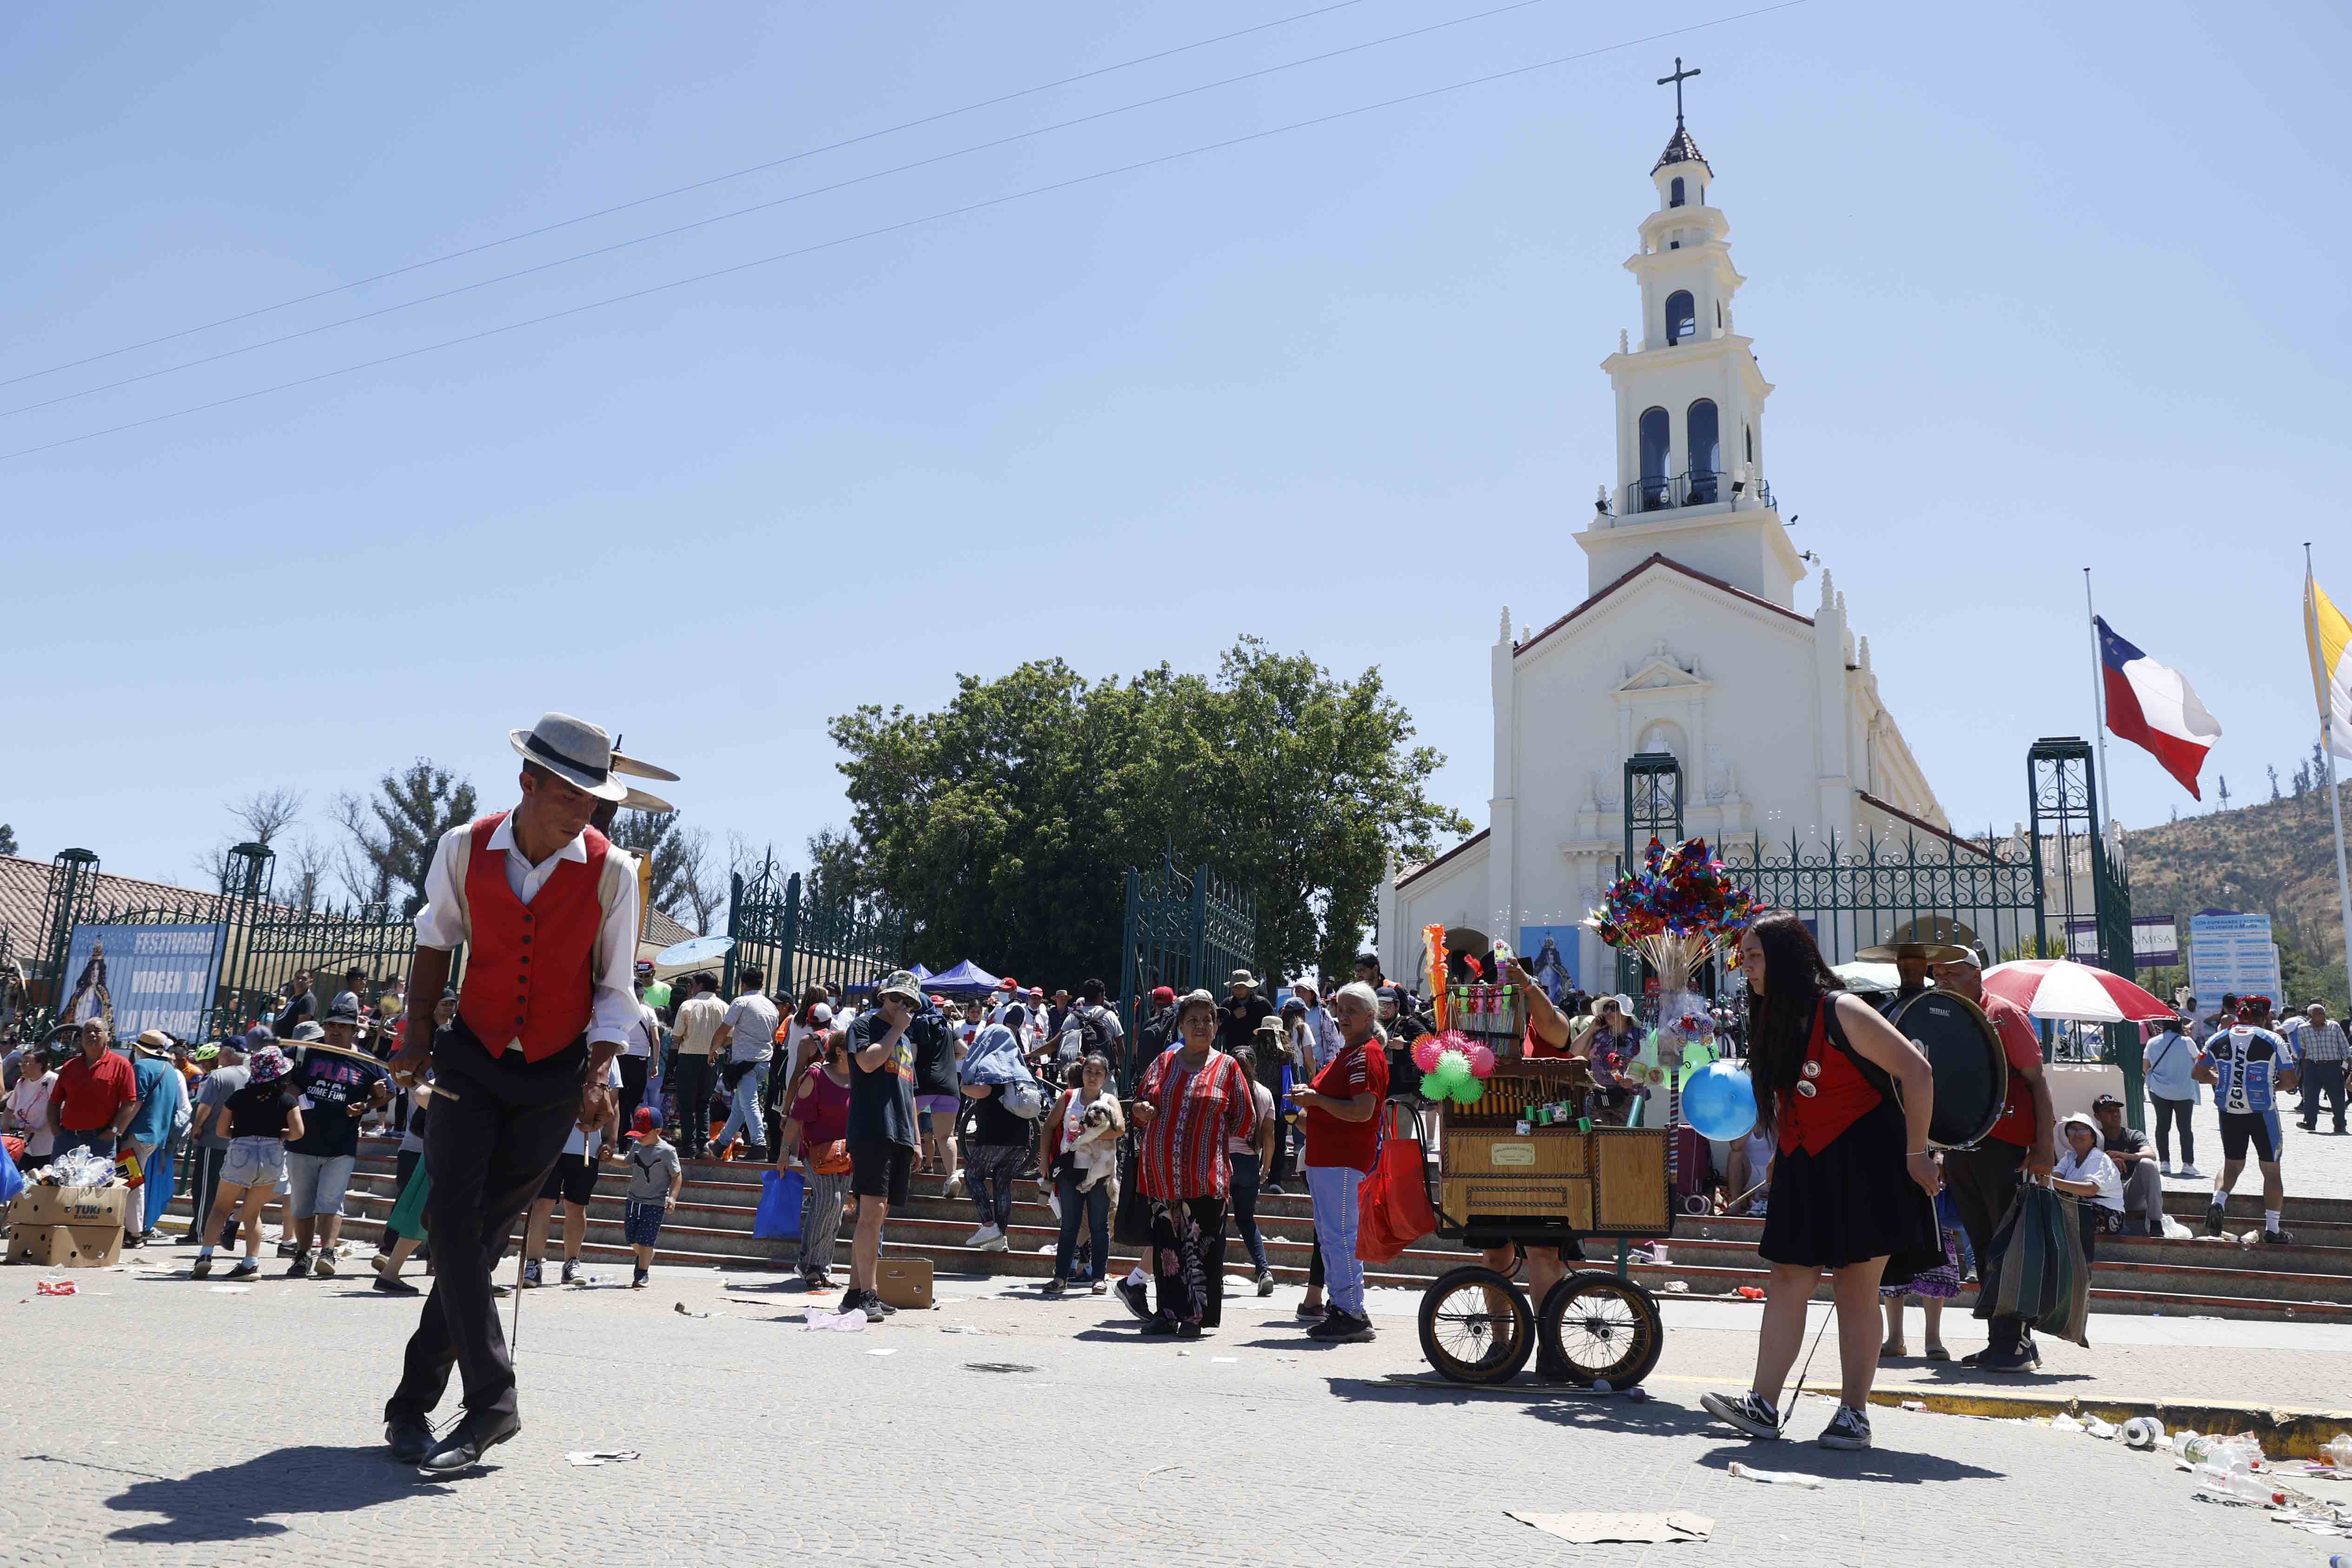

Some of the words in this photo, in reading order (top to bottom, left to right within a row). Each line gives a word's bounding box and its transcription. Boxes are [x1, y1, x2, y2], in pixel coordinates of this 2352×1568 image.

[133, 932, 215, 954] FESTIVIDAD
[2141, 935, 2172, 945] MISA
[132, 971, 182, 993] VIRGEN
[186, 971, 208, 993] DE
[119, 1010, 138, 1032] LO
[2230, 1045, 2245, 1100] GIANT
[306, 1085, 328, 1097] SOME
[328, 1090, 346, 1102] FUN!
